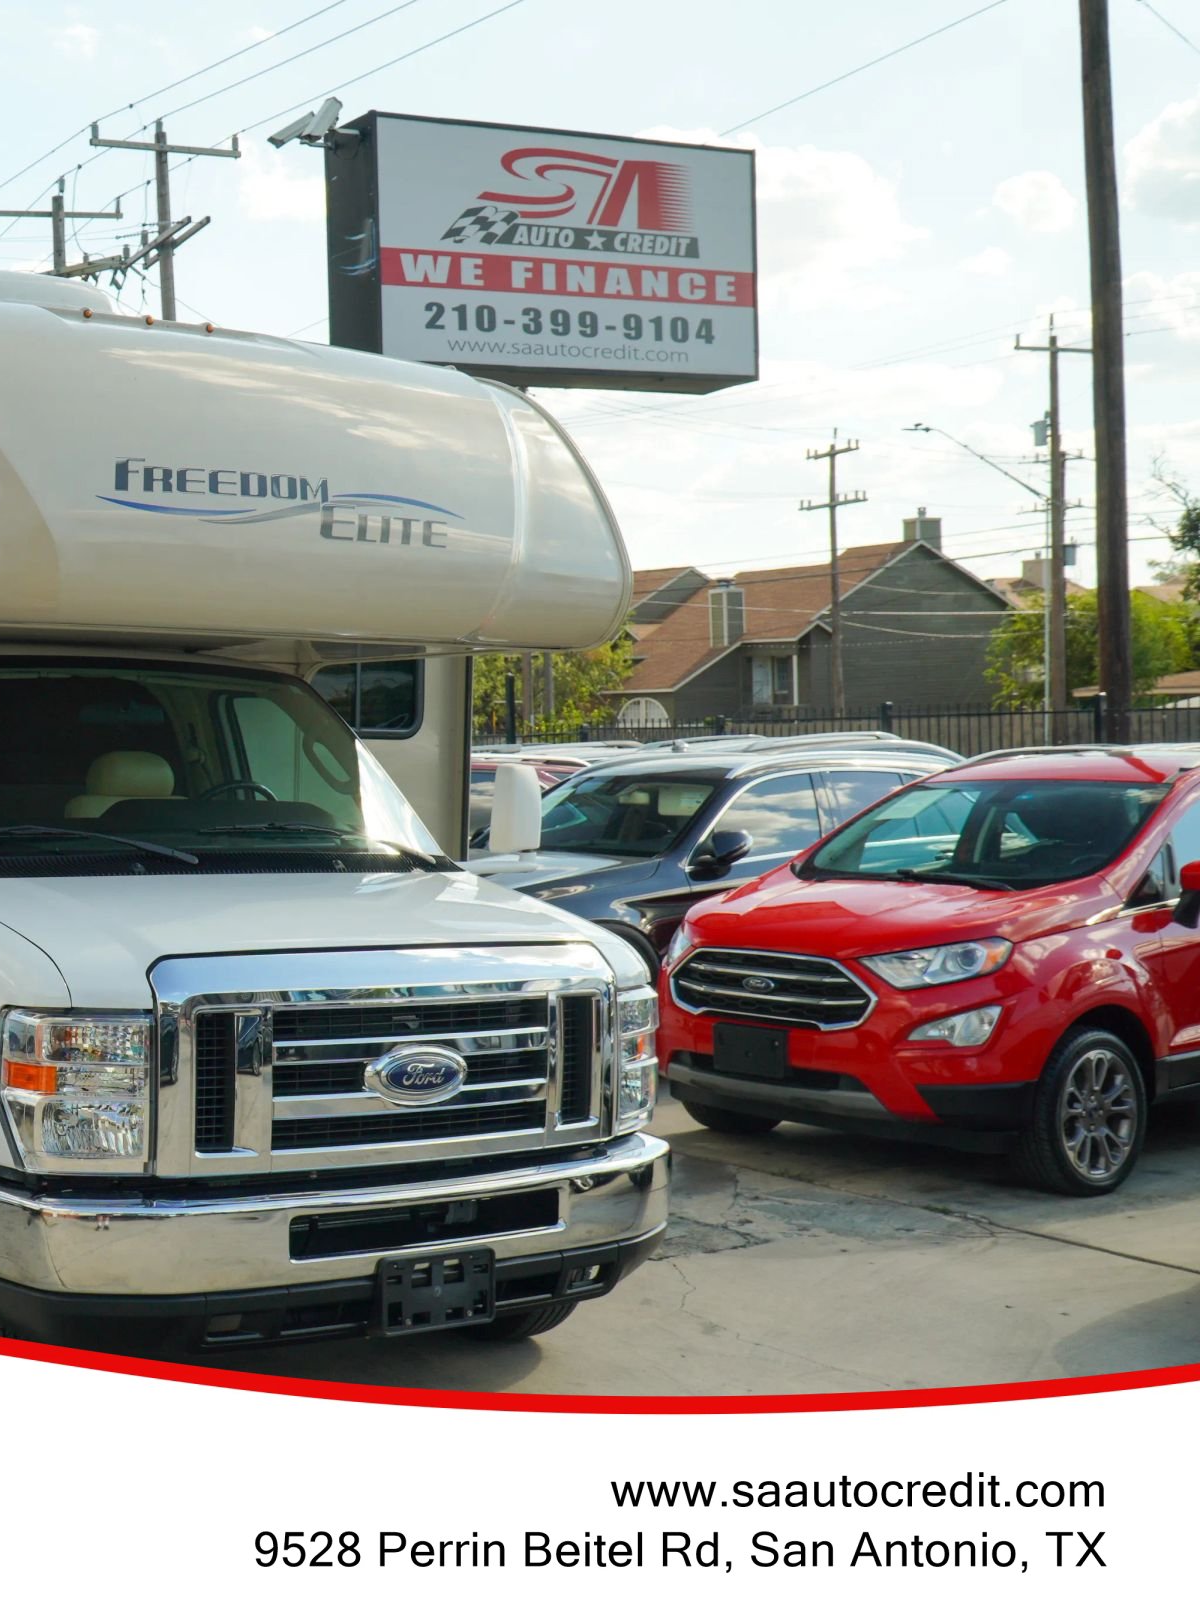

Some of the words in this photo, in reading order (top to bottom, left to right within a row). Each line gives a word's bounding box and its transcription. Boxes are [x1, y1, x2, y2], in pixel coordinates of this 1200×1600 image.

[477, 148, 693, 232] SA
[512, 224, 576, 248] AUTO
[613, 231, 691, 257] CREDIT
[400, 253, 485, 287] WE
[511, 260, 737, 303] FINANCE
[424, 301, 716, 345] 210-399-9104
[447, 338, 690, 364] www.saautocredit.com
[402, 1063, 445, 1086] Ford
